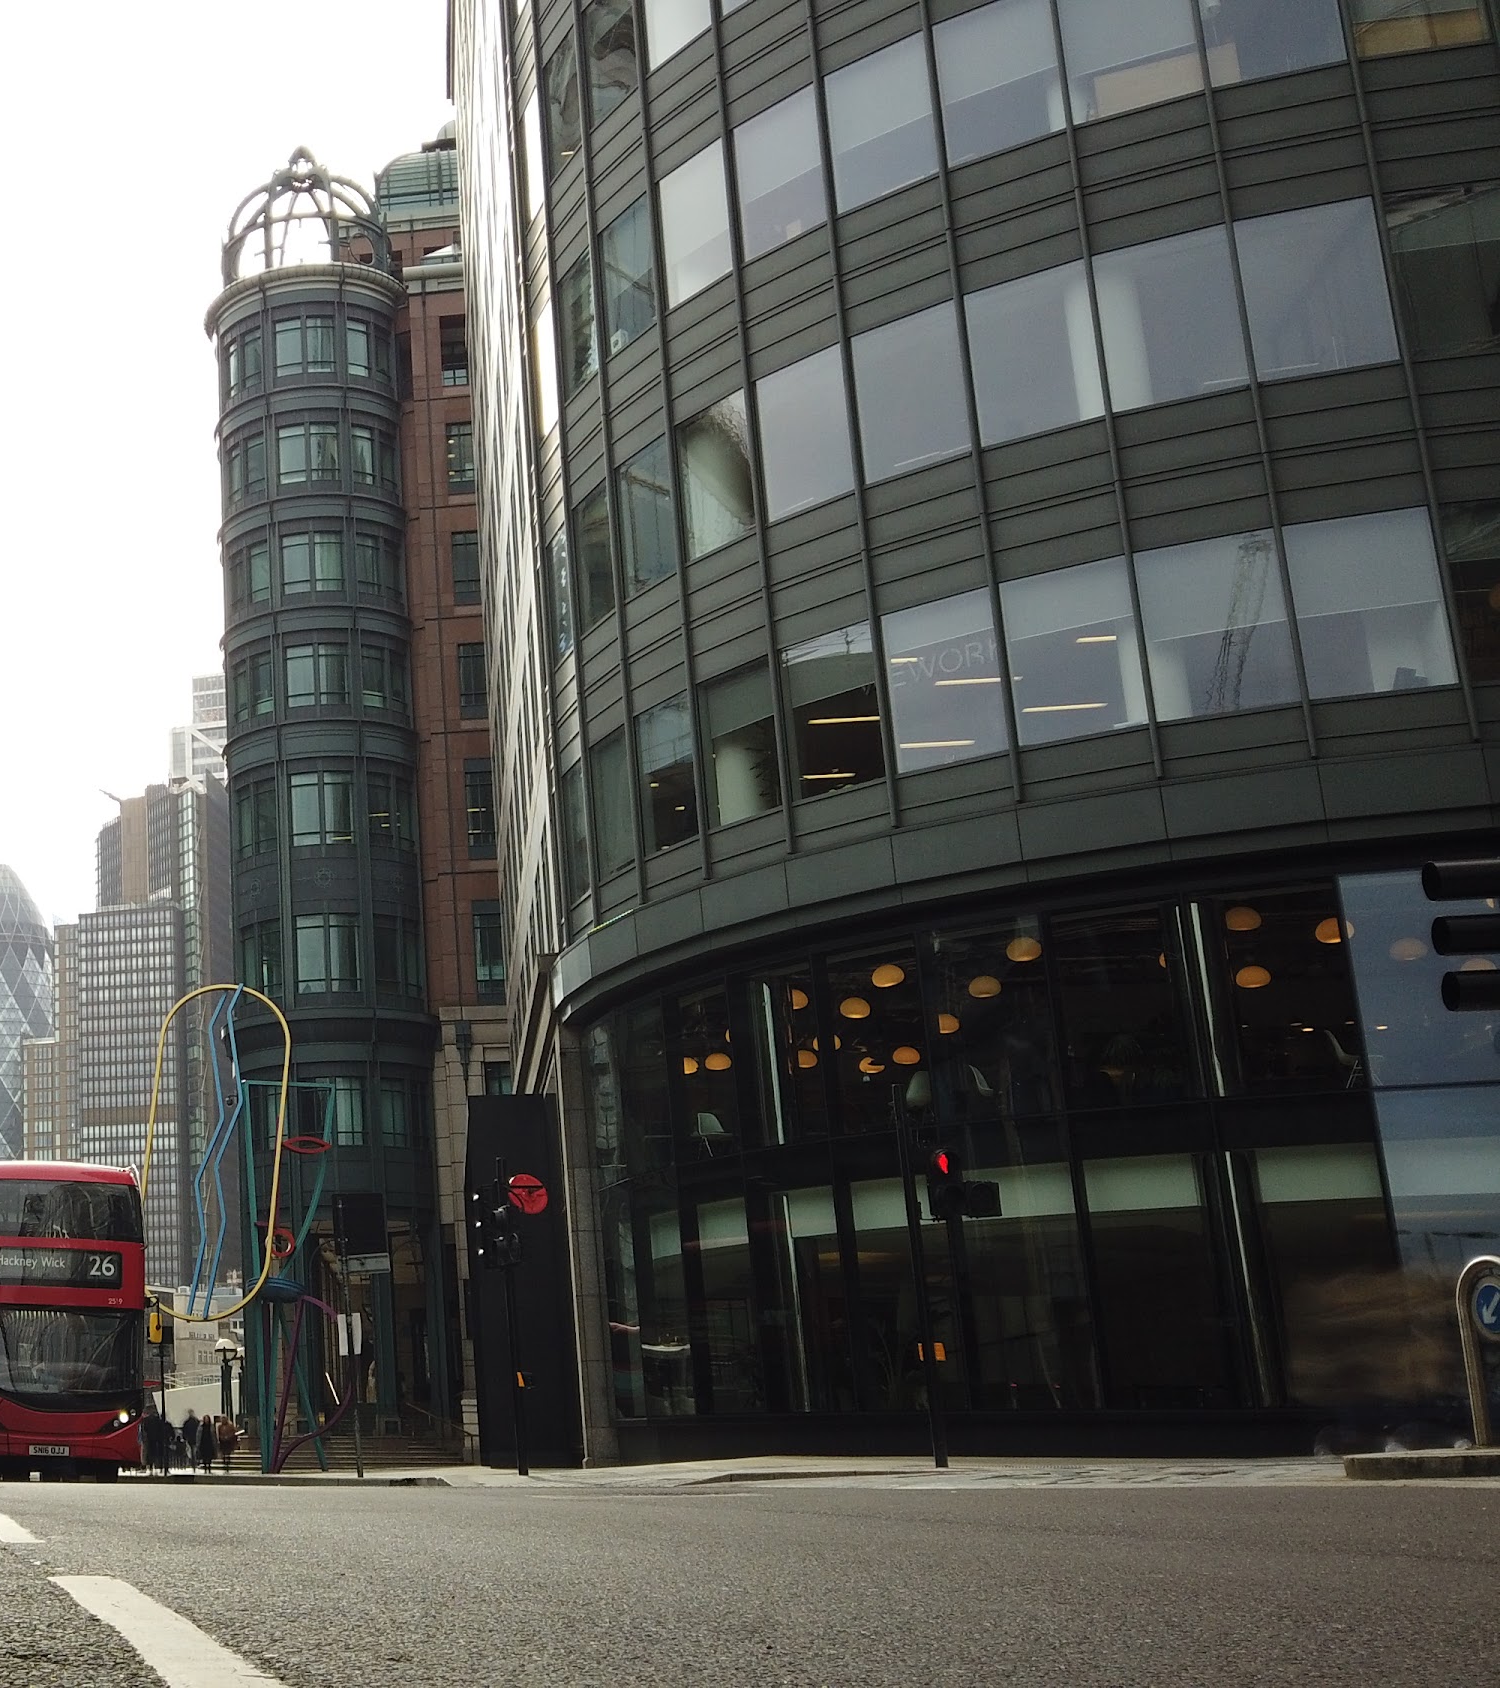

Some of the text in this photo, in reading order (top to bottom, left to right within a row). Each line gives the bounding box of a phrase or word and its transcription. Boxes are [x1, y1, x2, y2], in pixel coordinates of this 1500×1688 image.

[41, 1256, 66, 1269] Wick
[89, 1256, 115, 1276] 26
[33, 1446, 49, 1454] SN16
